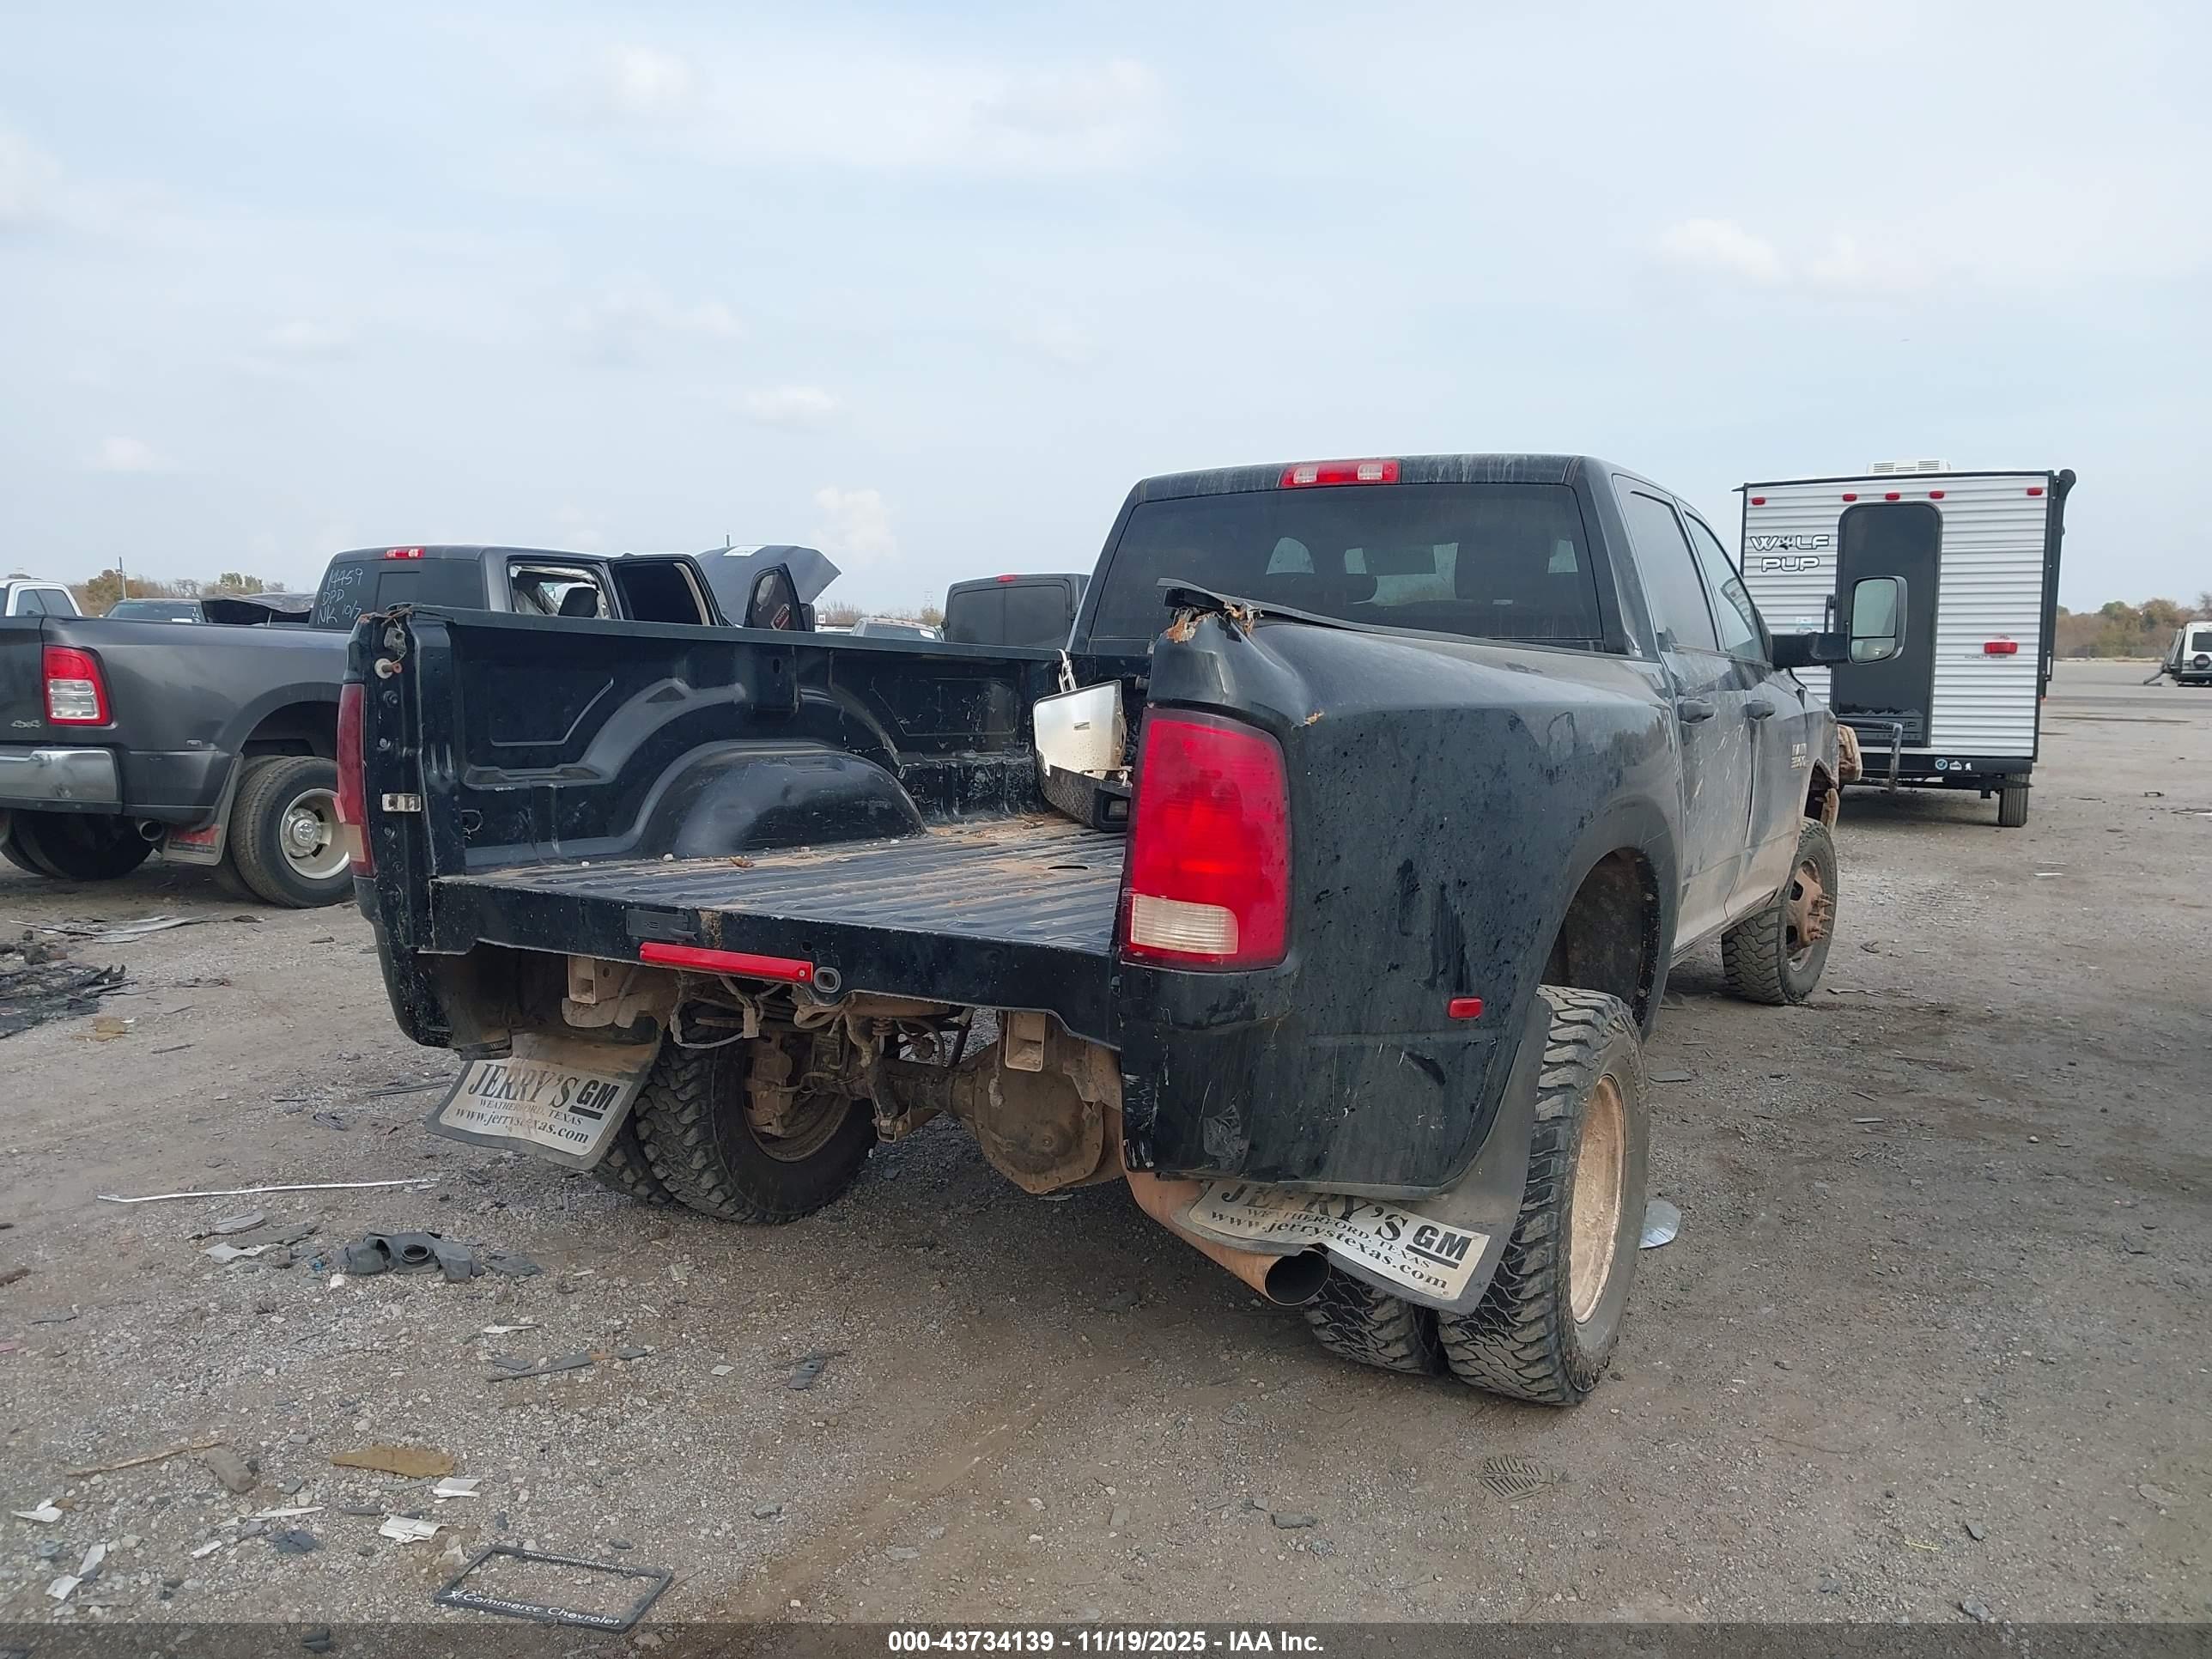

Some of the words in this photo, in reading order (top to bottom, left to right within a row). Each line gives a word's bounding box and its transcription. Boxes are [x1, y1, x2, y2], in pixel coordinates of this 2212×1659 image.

[1760, 556, 1820, 572] PUP
[322, 589, 344, 606] DPD
[342, 599, 362, 620] 10/7
[467, 1063, 578, 1109] JERRY'S
[576, 1079, 620, 1111] GM
[549, 1109, 584, 1127] TEXAS
[1211, 1211, 1448, 1290] www.jerrystexas.com
[1248, 1208, 1372, 1244] WETHERFORD,
[1379, 1242, 1431, 1269] TEXAS
[1412, 1224, 1474, 1262] GM
[524, 1551, 636, 1572] www.commercechevy.com
[463, 1594, 543, 1613] Commerce
[547, 1606, 620, 1626] Chevrolet
